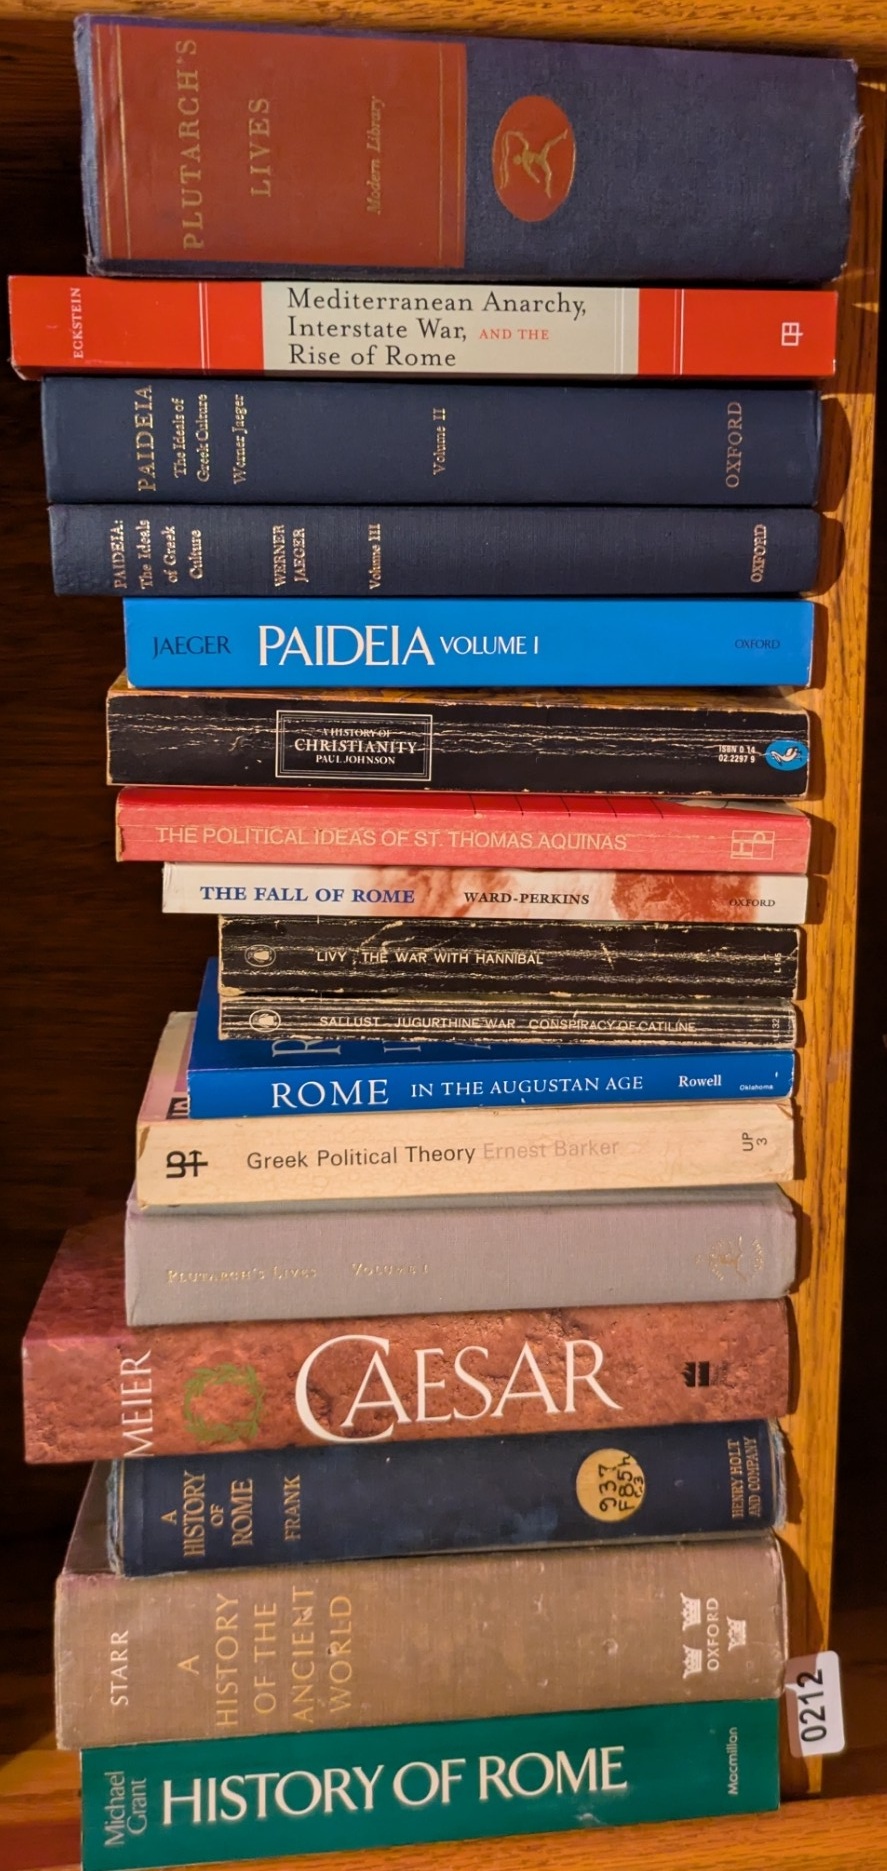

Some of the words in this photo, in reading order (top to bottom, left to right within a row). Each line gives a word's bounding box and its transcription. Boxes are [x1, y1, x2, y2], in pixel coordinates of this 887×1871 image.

[176, 39, 205, 250] PLUTARCH'S
[367, 96, 385, 153] Library
[250, 98, 271, 197] LIVES
[366, 157, 381, 215] Modern
[71, 287, 84, 359] ECKSTEIN
[287, 287, 473, 311] Mediterranean
[481, 291, 586, 321] Anarchy,
[288, 316, 407, 338] Interstate
[417, 319, 466, 342] War,
[479, 329, 512, 340] AND
[518, 329, 549, 340] THE
[288, 344, 340, 365] Rise
[351, 345, 378, 365] of
[386, 345, 456, 367] Rome
[171, 397, 184, 411] of
[195, 393, 209, 441] Culture
[232, 394, 248, 434] Jaeger
[433, 408, 446, 421] II
[134, 385, 156, 491] PAIDEIA
[172, 414, 186, 451] Ideals
[433, 426, 446, 475] Volume
[725, 401, 742, 489] OXFORD
[174, 452, 187, 478] The
[196, 443, 210, 482] Greek
[232, 435, 247, 484] Werner
[136, 519, 151, 559] Ideals
[161, 525, 176, 566] Greek
[368, 523, 381, 542] III
[110, 519, 127, 589] PAIDEIA:
[189, 529, 203, 580] Culture
[272, 524, 286, 587] WERNER
[293, 528, 309, 583] JAEGER
[369, 544, 382, 590] Volume
[750, 524, 767, 584] OXFORD
[139, 563, 153, 589] The
[163, 569, 178, 583] of
[152, 635, 232, 659] JAEGER
[258, 625, 435, 666] PAIDEIA
[440, 636, 525, 655] VOLUME
[533, 636, 539, 654] I
[734, 639, 781, 649] OXFORD
[294, 738, 418, 754] CHRISTIANITY
[330, 728, 375, 738] HISTORY
[719, 745, 737, 753] ISBN
[739, 745, 745, 753] 0
[747, 746, 756, 754] 14
[315, 754, 342, 764] PAUL
[343, 755, 396, 765] JOHNSON
[155, 827, 198, 843] THE
[203, 827, 309, 845] POLITICAL
[314, 829, 376, 846] IDEAS
[381, 830, 409, 847] OF
[414, 830, 444, 847] ST.
[451, 832, 537, 849] THOMAS
[540, 833, 627, 851] AQUINAS
[200, 886, 247, 900] THE
[254, 887, 309, 902] FALL
[315, 888, 345, 902] OF
[352, 889, 415, 903] ROME
[464, 891, 590, 905] WARD-PERKINS
[729, 898, 776, 908] OXFORD
[316, 952, 347, 962] LIVY
[362, 952, 388, 963] THE
[395, 952, 427, 963] WAR
[434, 952, 469, 963] WITH
[475, 953, 543, 965] HANNIBAL
[319, 1016, 381, 1027] SALLUST
[394, 1017, 480, 1028] JUGURTHINE
[484, 1018, 516, 1029] WAR
[529, 1019, 617, 1031] CONSPIRACY
[618, 1021, 636, 1031] OF
[639, 1021, 697, 1032] CATILINE
[271, 1079, 389, 1108] ROME
[411, 1083, 433, 1097] IN
[441, 1081, 483, 1096] THE
[490, 1077, 599, 1094] AUGUSTAN
[605, 1076, 643, 1090] AGE
[678, 1074, 722, 1088] Rowell
[739, 1083, 774, 1092] Oklahoma
[247, 1151, 308, 1169] Greek
[317, 1146, 397, 1167] Political
[405, 1146, 476, 1164] Theory
[483, 1142, 547, 1160] Ernest
[555, 1139, 621, 1157] Barker
[742, 1131, 754, 1152] UP
[757, 1137, 768, 1147] 3
[119, 1349, 154, 1457] MEIER
[295, 1334, 624, 1443] CAESAR
[727, 1439, 742, 1475] HOLT
[743, 1436, 760, 1495] COMPANY
[283, 1474, 301, 1541] FRANK
[598, 1463, 617, 1513] 937
[729, 1477, 744, 1519] HENRY
[748, 1499, 761, 1518] AND
[160, 1509, 178, 1526] A
[183, 1470, 205, 1558] HISTORY
[210, 1503, 225, 1528] OF
[231, 1478, 253, 1547] ROME
[254, 1602, 277, 1662] THE
[706, 1598, 720, 1672] OXFORD
[110, 1630, 129, 1706] STARR
[177, 1655, 200, 1676] A
[215, 1592, 239, 1727] HISTORY
[292, 1585, 315, 1723] ANCIENT
[329, 1596, 353, 1713] WORLD
[254, 1676, 276, 1715] OF
[796, 1668, 827, 1743] 0212
[727, 1726, 739, 1795] Macmillan
[162, 1764, 385, 1825] HISTORY
[392, 1758, 466, 1806] OF
[479, 1745, 628, 1801] ROME
[104, 1770, 125, 1847] Michael
[126, 1778, 147, 1835] Grant
